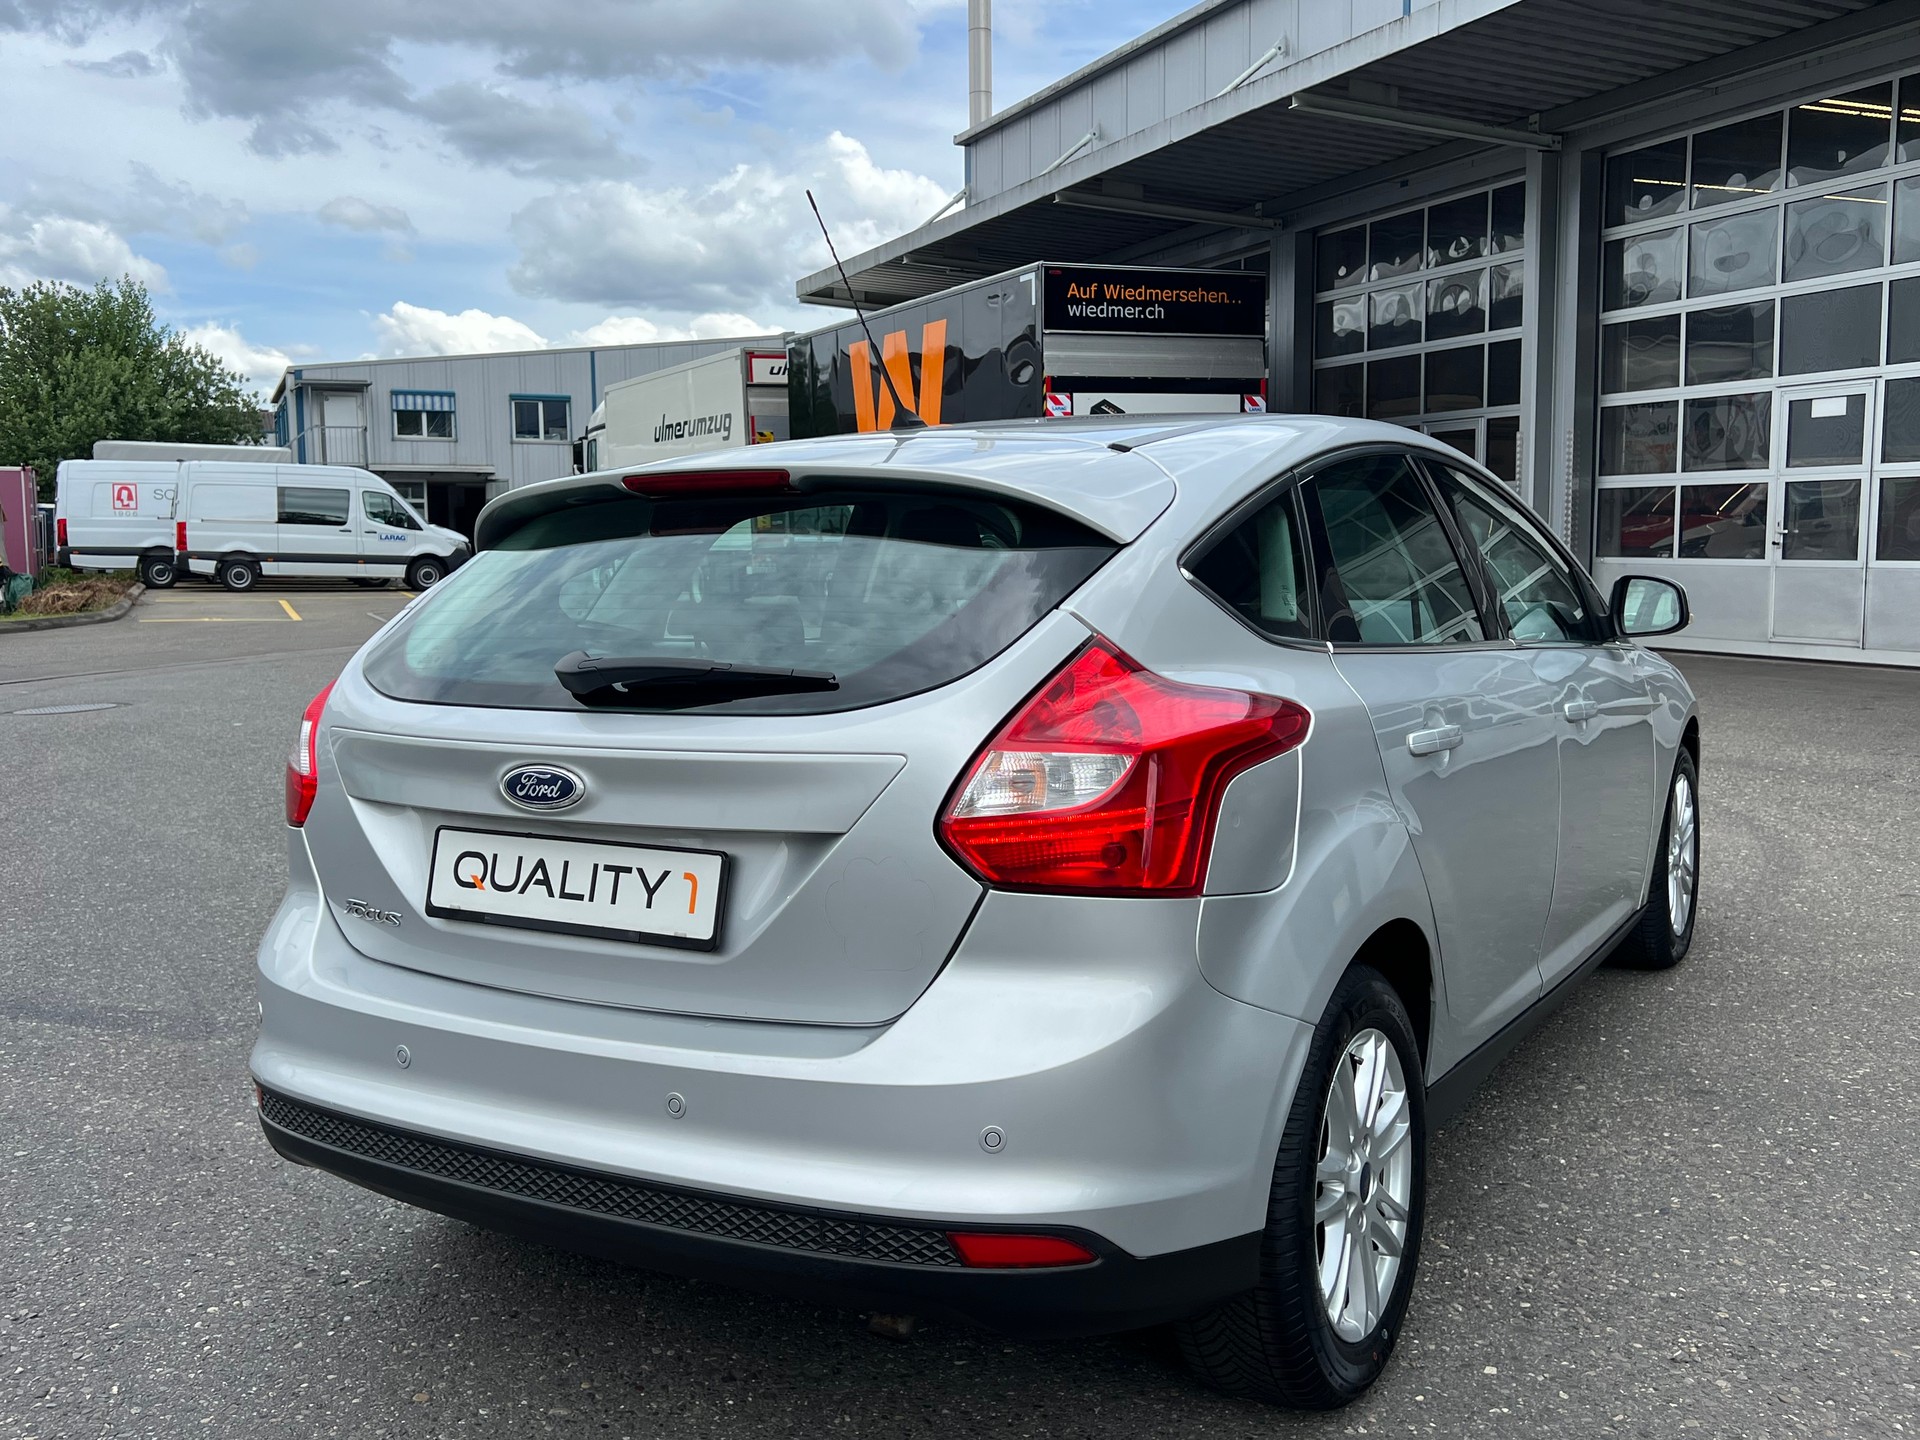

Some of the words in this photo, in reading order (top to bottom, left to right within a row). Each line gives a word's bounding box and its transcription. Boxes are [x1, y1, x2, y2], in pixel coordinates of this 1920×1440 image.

[1067, 282, 1098, 299] Auf
[1103, 284, 1242, 304] Wiedmersehen...
[1067, 302, 1165, 319] wiedmer.ch
[654, 413, 733, 442] ulmerumzug
[516, 771, 561, 799] Ford
[453, 850, 672, 909] QUALITY
[682, 872, 698, 914] 1
